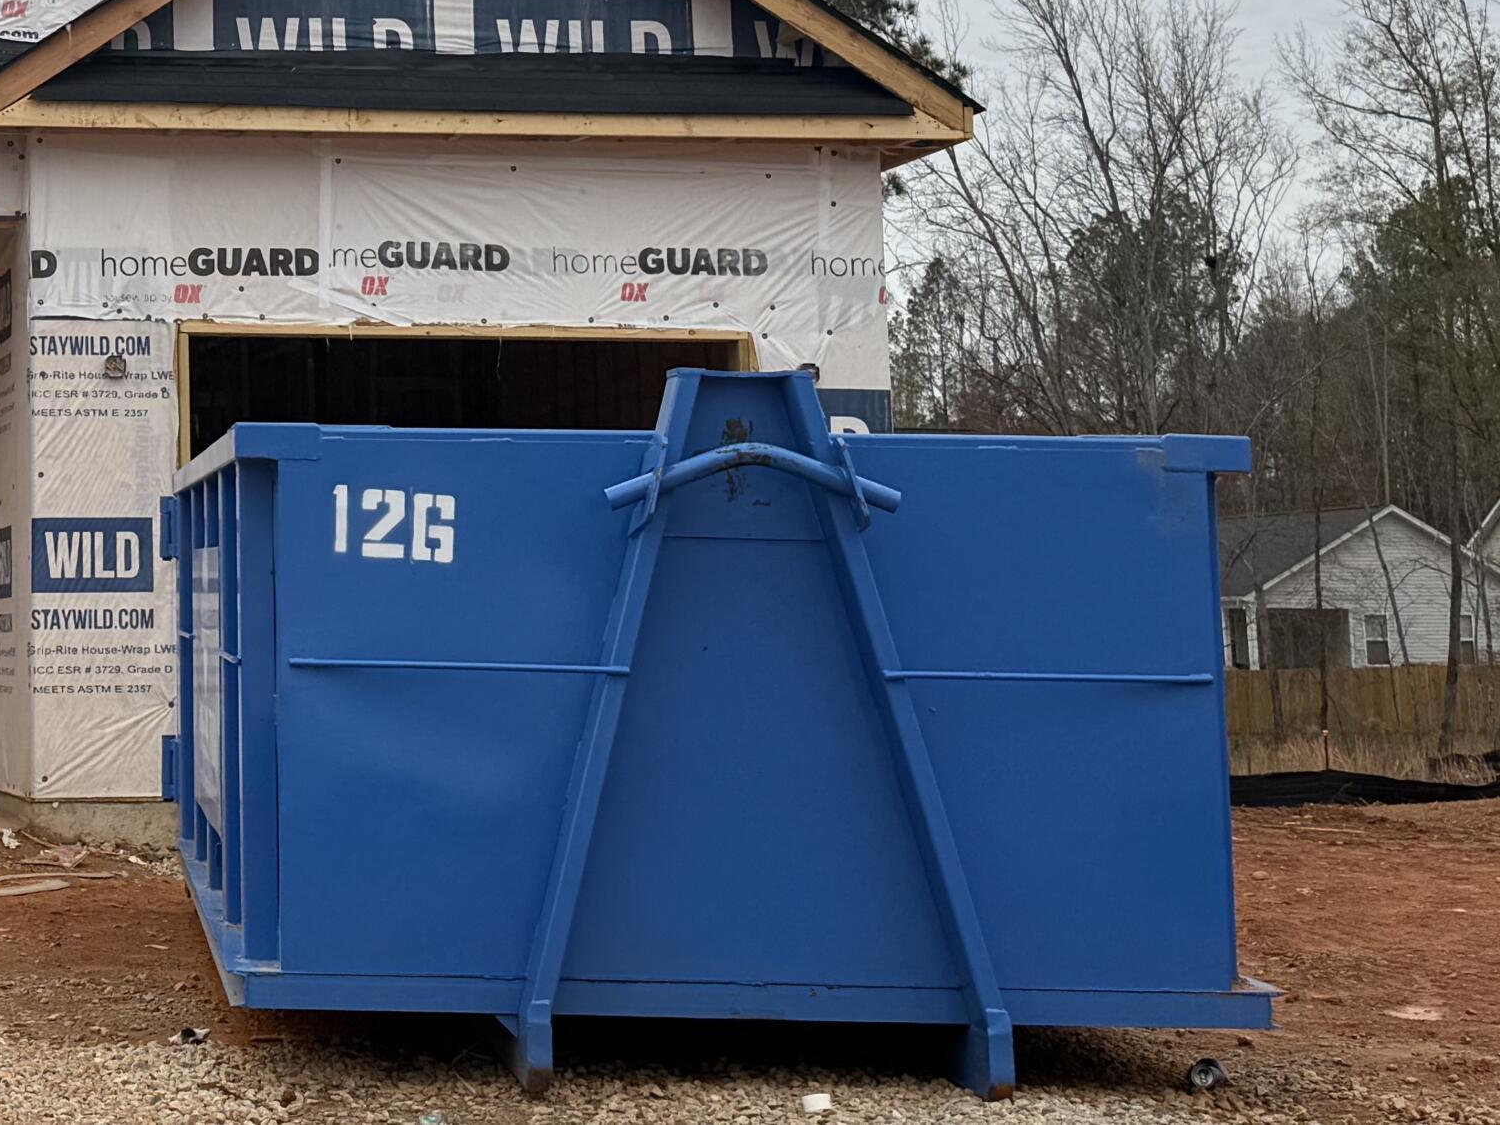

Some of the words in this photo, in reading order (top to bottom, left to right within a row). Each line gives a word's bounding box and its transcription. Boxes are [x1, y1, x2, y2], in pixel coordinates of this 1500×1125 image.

[2, 0, 28, 18] OX
[101, 248, 319, 277] homeGUARD
[328, 240, 510, 272] meGUARD
[552, 246, 768, 277] homeGUARD
[174, 284, 202, 303] OX
[361, 276, 390, 295] OX
[621, 282, 649, 302] OX
[30, 336, 150, 355] STAYWILD.COM
[55, 390, 78, 398] ESR
[124, 390, 157, 398] Grade
[32, 409, 72, 417] MEETS
[75, 409, 107, 417] ASTM
[112, 409, 119, 417] E
[124, 409, 148, 417] 2357
[45, 531, 140, 578] WILD
[31, 609, 154, 629] STAYWILD.COM
[82, 645, 150, 655] House-Wrap
[33, 666, 54, 674] ICC
[58, 666, 81, 674] ESR
[85, 666, 91, 674] #
[128, 665, 161, 674] Grade
[165, 665, 172, 673] D
[33, 685, 74, 694] MEETS
[78, 685, 111, 693] ASTM
[115, 685, 122, 693] E
[127, 685, 152, 693] 2357
